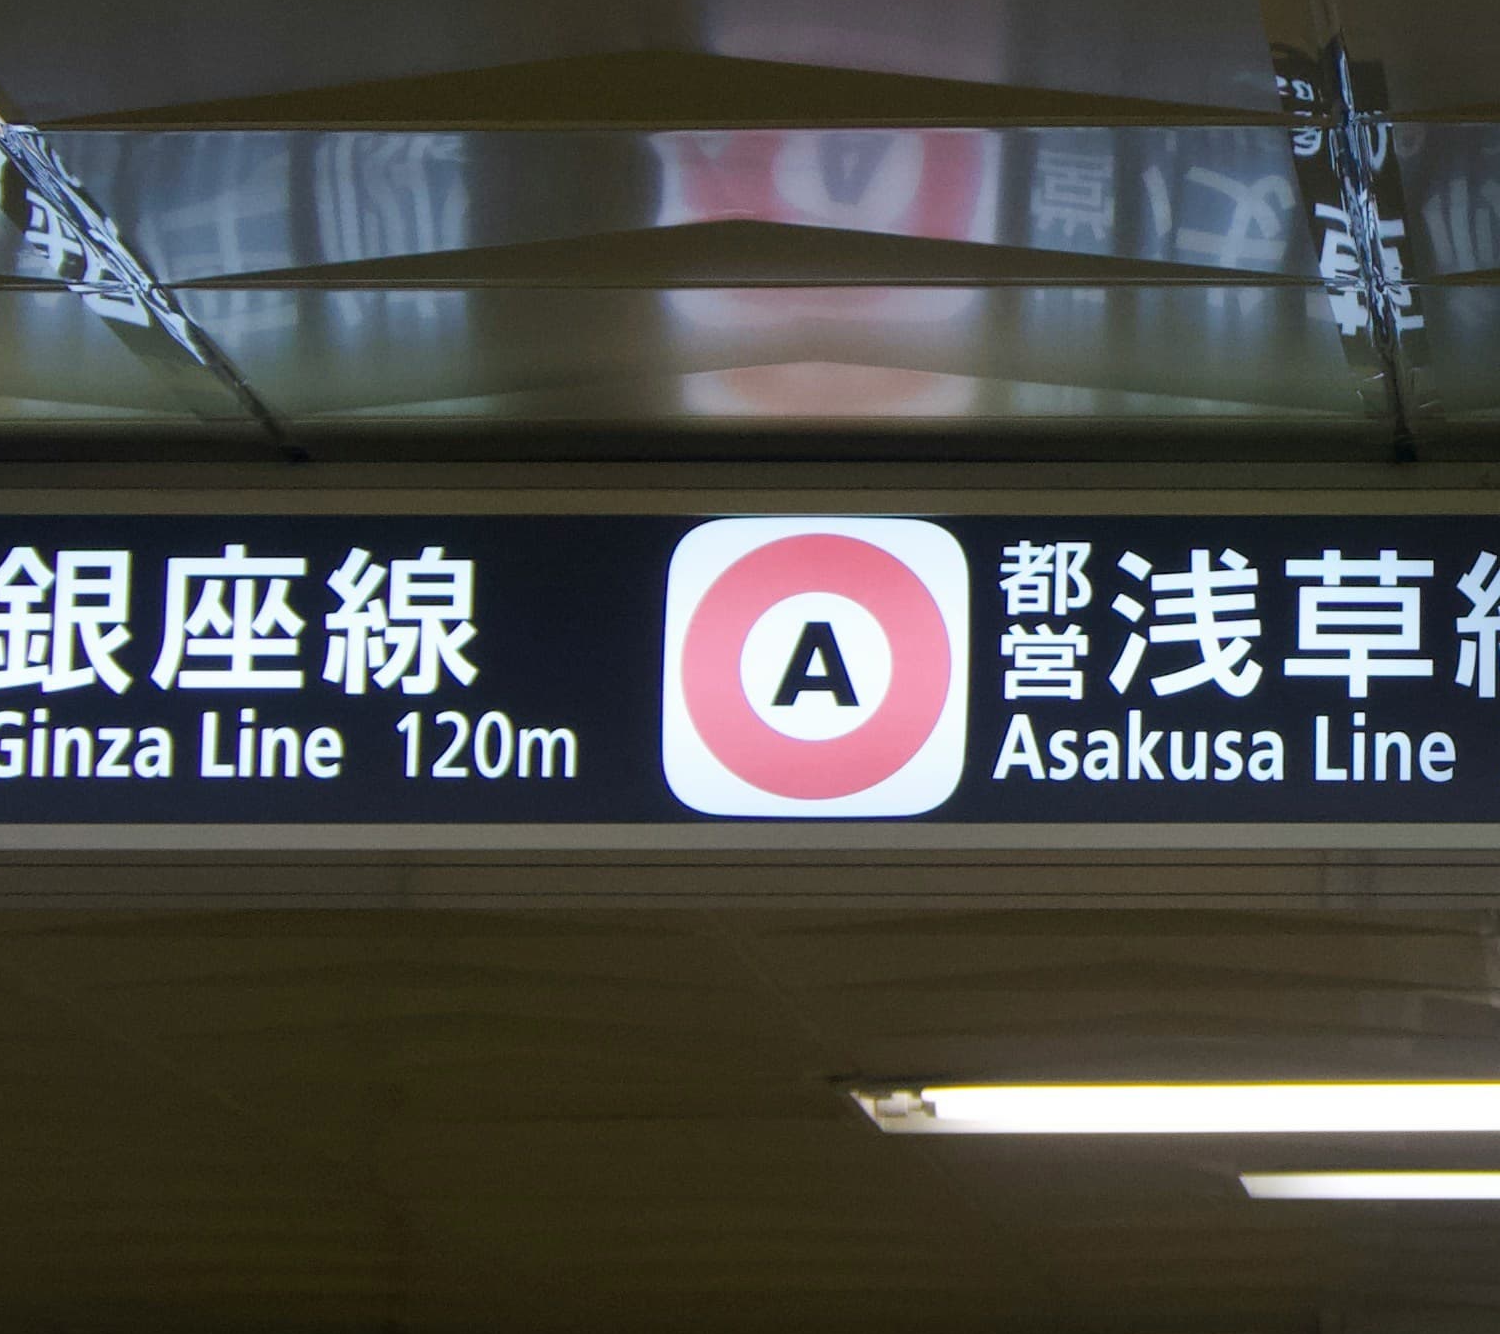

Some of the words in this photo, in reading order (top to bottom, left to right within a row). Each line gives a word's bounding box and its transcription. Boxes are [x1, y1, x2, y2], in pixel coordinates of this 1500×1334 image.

[1000, 541, 1092, 699] 都営
[774, 622, 858, 706] A
[201, 708, 343, 778] Line
[397, 711, 576, 778] 120m
[993, 710, 1283, 781] Asakusa
[1316, 713, 1455, 781] Line
